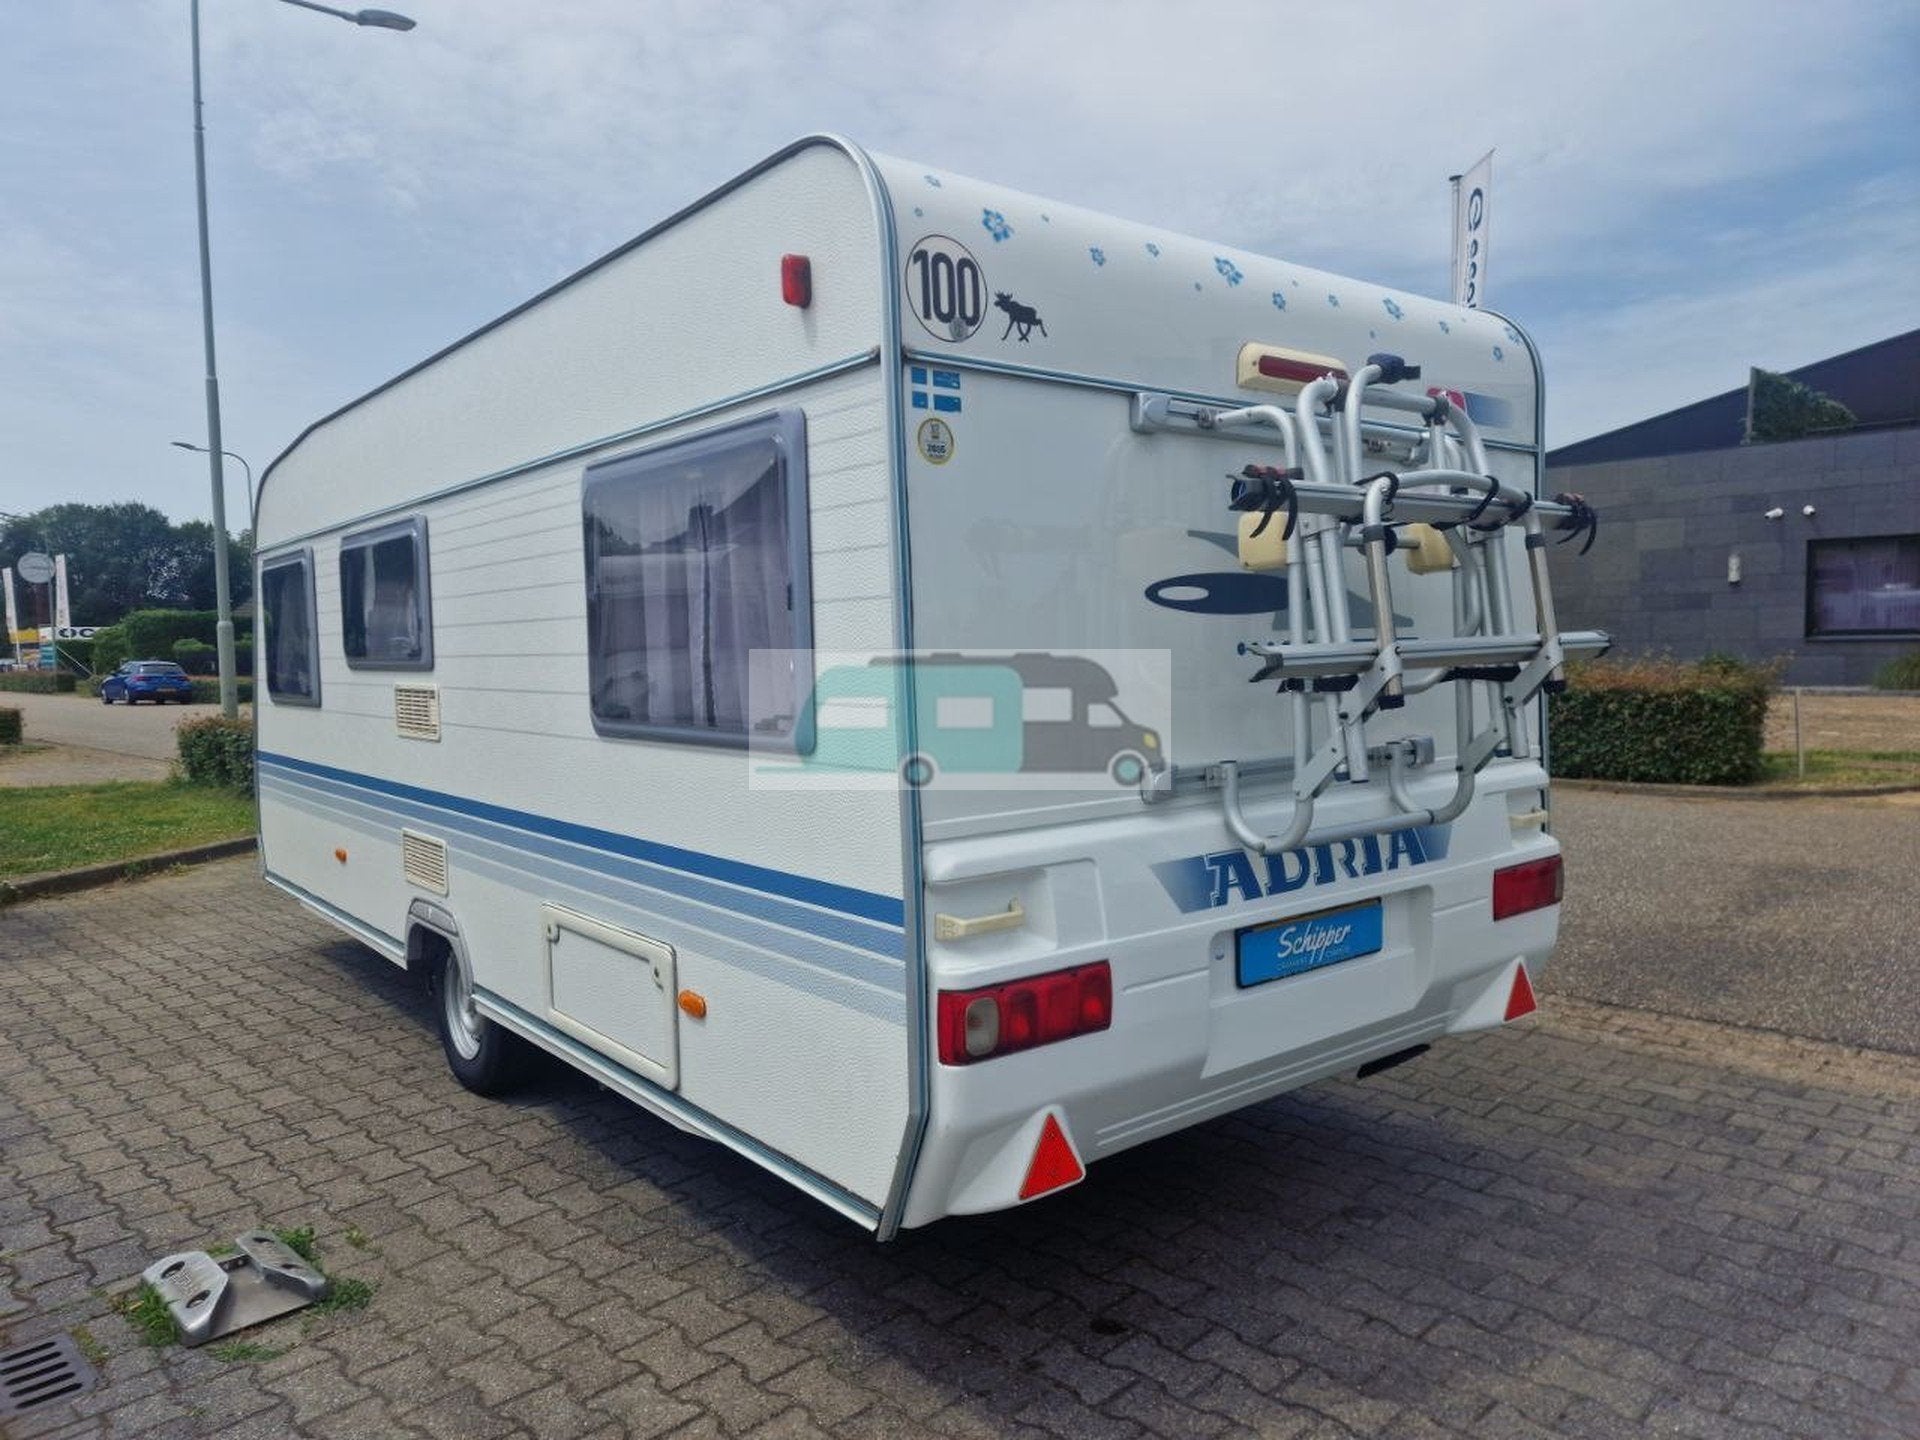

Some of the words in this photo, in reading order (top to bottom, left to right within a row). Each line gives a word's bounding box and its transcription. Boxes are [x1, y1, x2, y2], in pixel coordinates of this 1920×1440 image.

[912, 249, 981, 327] 100
[1203, 825, 1430, 909] ADRIA
[1277, 921, 1351, 965] Schipper
